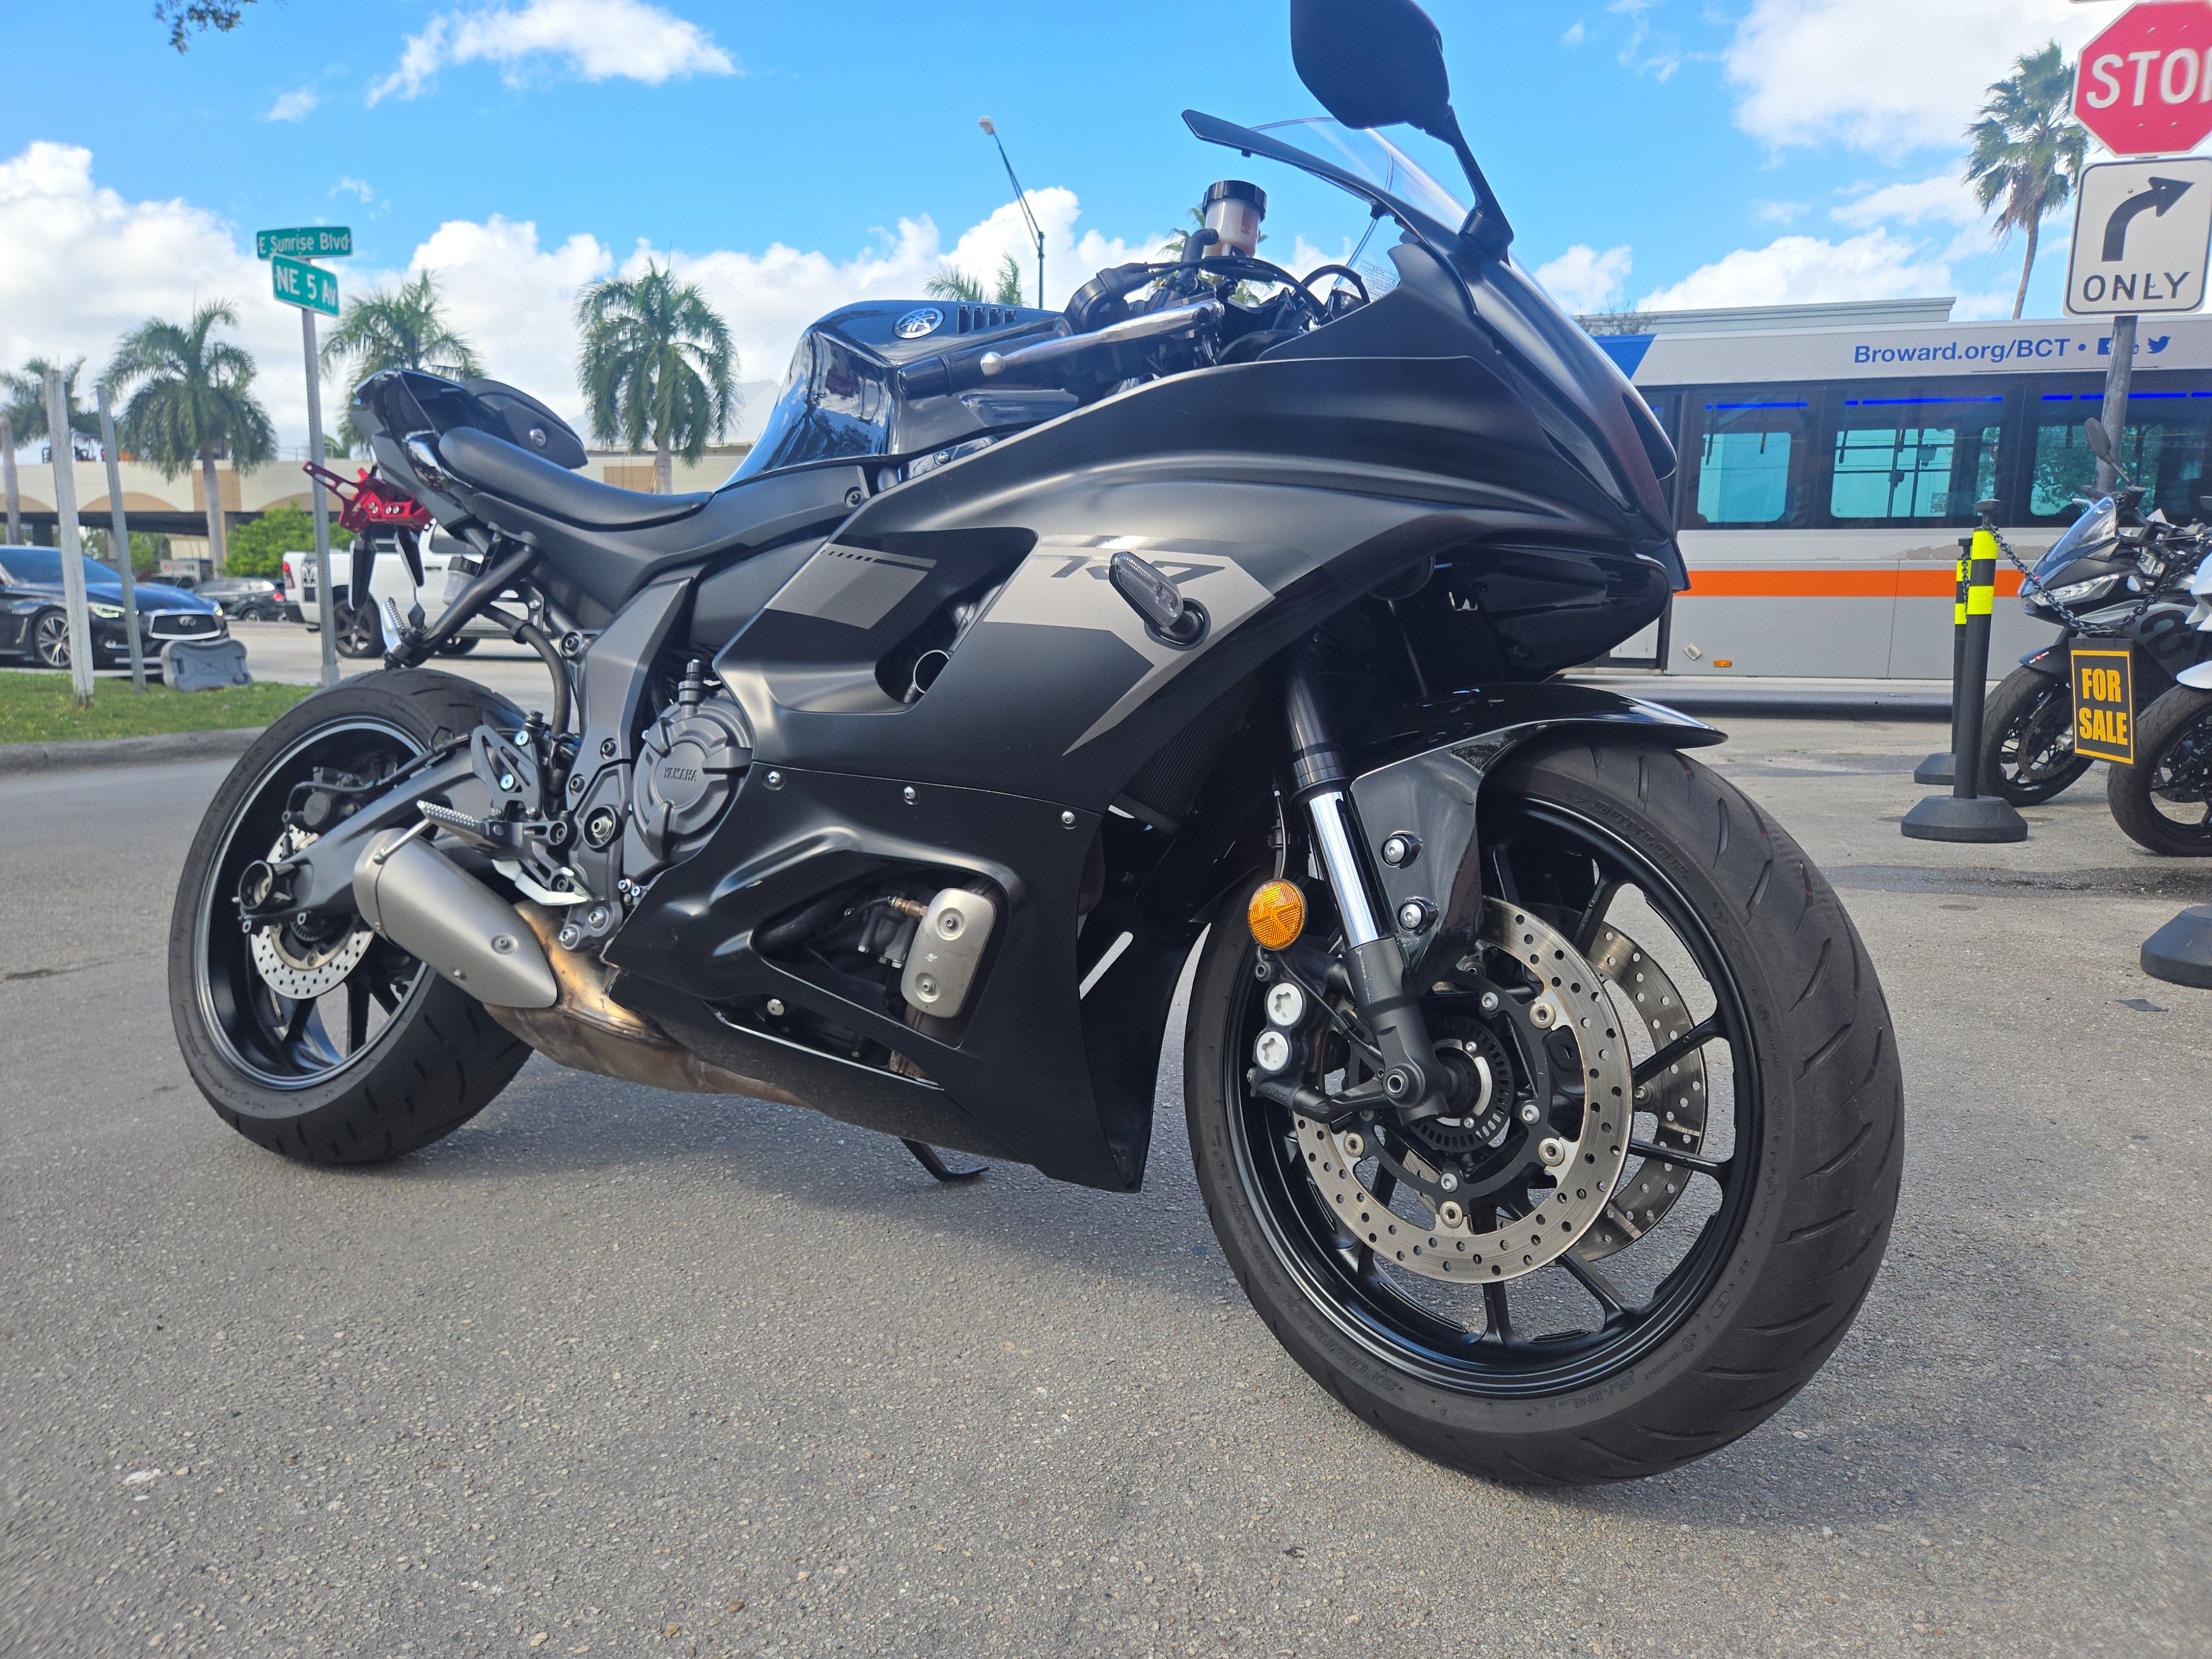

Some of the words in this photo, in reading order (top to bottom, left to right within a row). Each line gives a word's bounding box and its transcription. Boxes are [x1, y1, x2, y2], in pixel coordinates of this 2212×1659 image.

[258, 236, 267, 254] E
[270, 234, 315, 253] Sunrise
[320, 232, 348, 251] Blvd
[276, 265, 300, 295] NE
[307, 273, 317, 300] 5
[2083, 272, 2190, 302] ONLY
[1854, 338, 2070, 363] Broward.org/BCT
[2081, 668, 2121, 702] FOR
[2079, 707, 2128, 745] SALE
[664, 766, 698, 782] YAMAHA
[1592, 799, 1689, 873] DUNLOP
[1280, 1295, 1399, 1391] SPORTMAX
